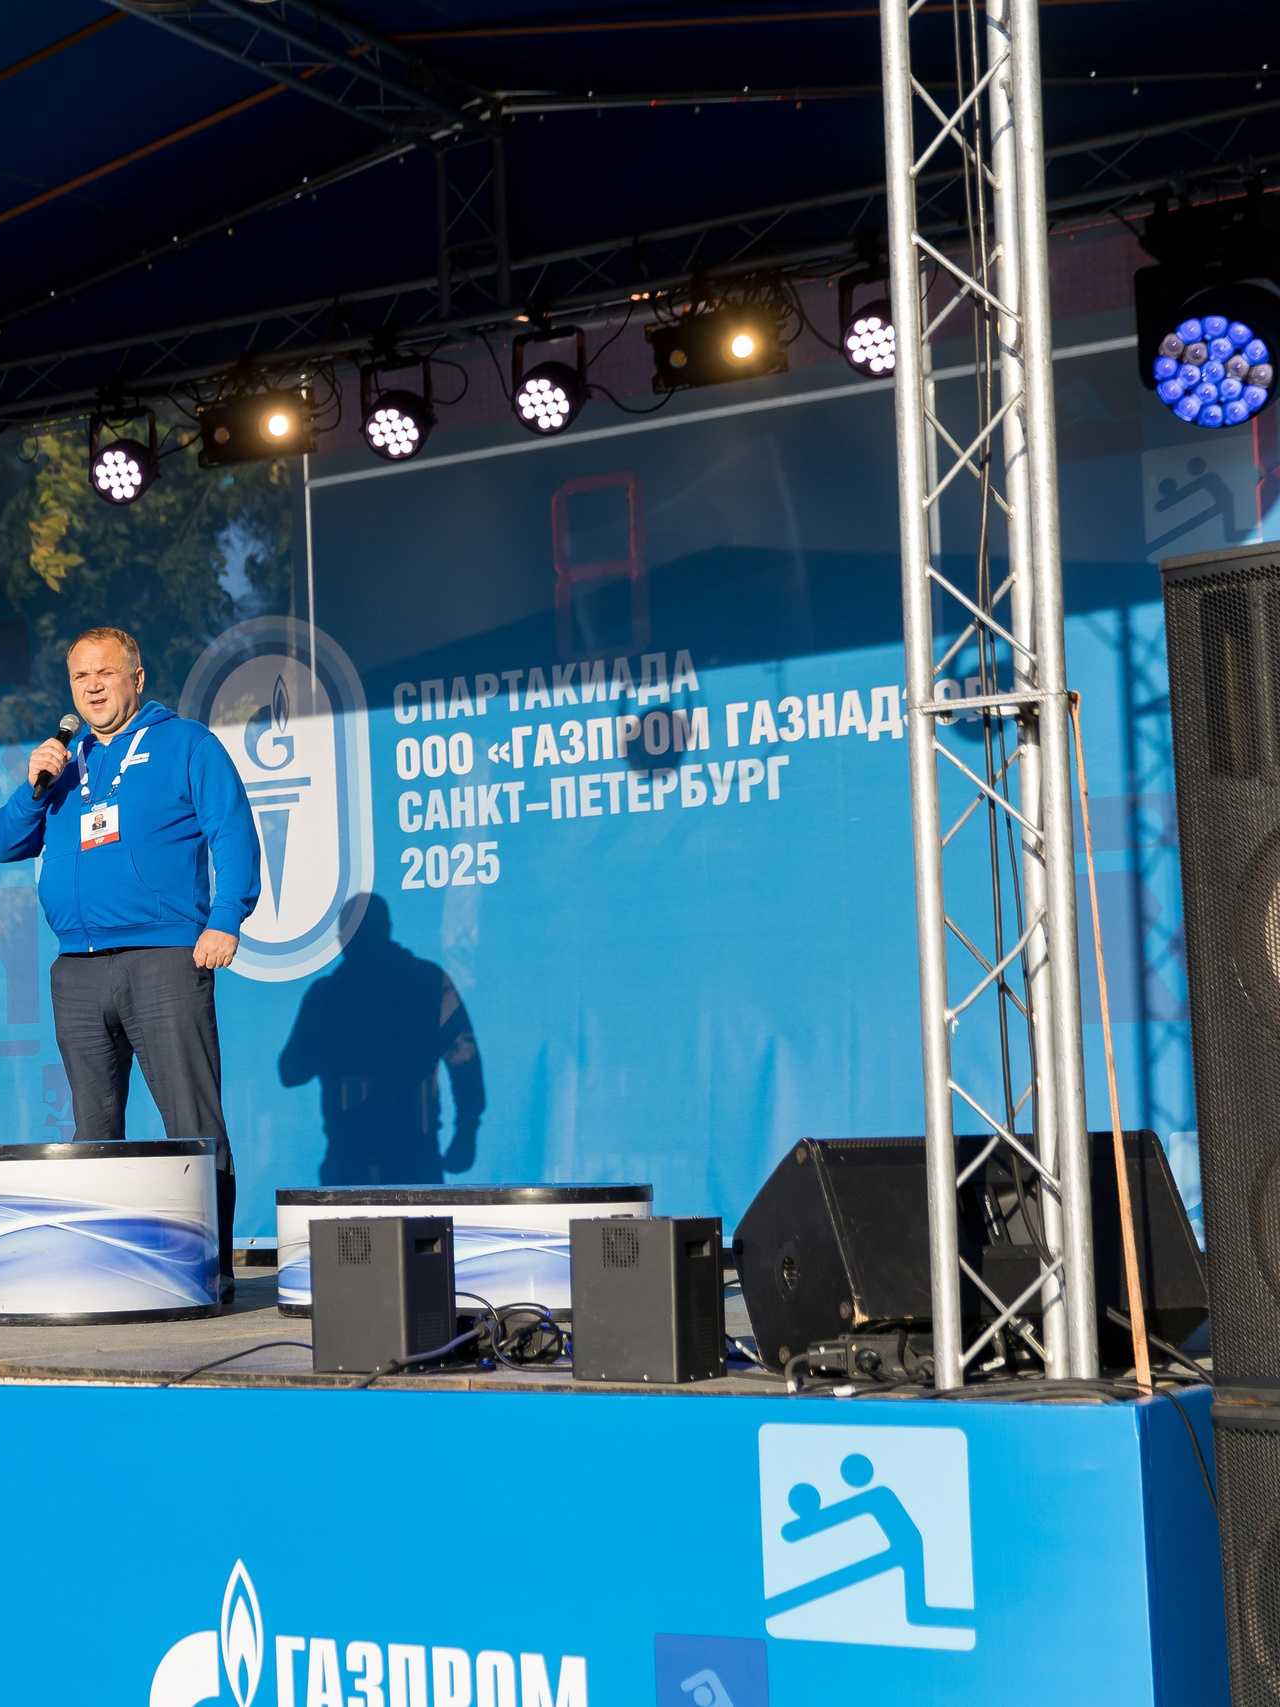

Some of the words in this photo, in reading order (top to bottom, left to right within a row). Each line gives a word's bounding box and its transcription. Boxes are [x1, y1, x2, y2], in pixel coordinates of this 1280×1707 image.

[393, 648, 700, 725] СПАРТАКИАДА
[395, 731, 474, 781] ООО
[487, 705, 711, 770] «ГАЗПРОМ
[94, 836, 106, 845] VIP
[401, 841, 501, 890] 2025
[275, 1635, 588, 1707] ГАЗПРОМ
